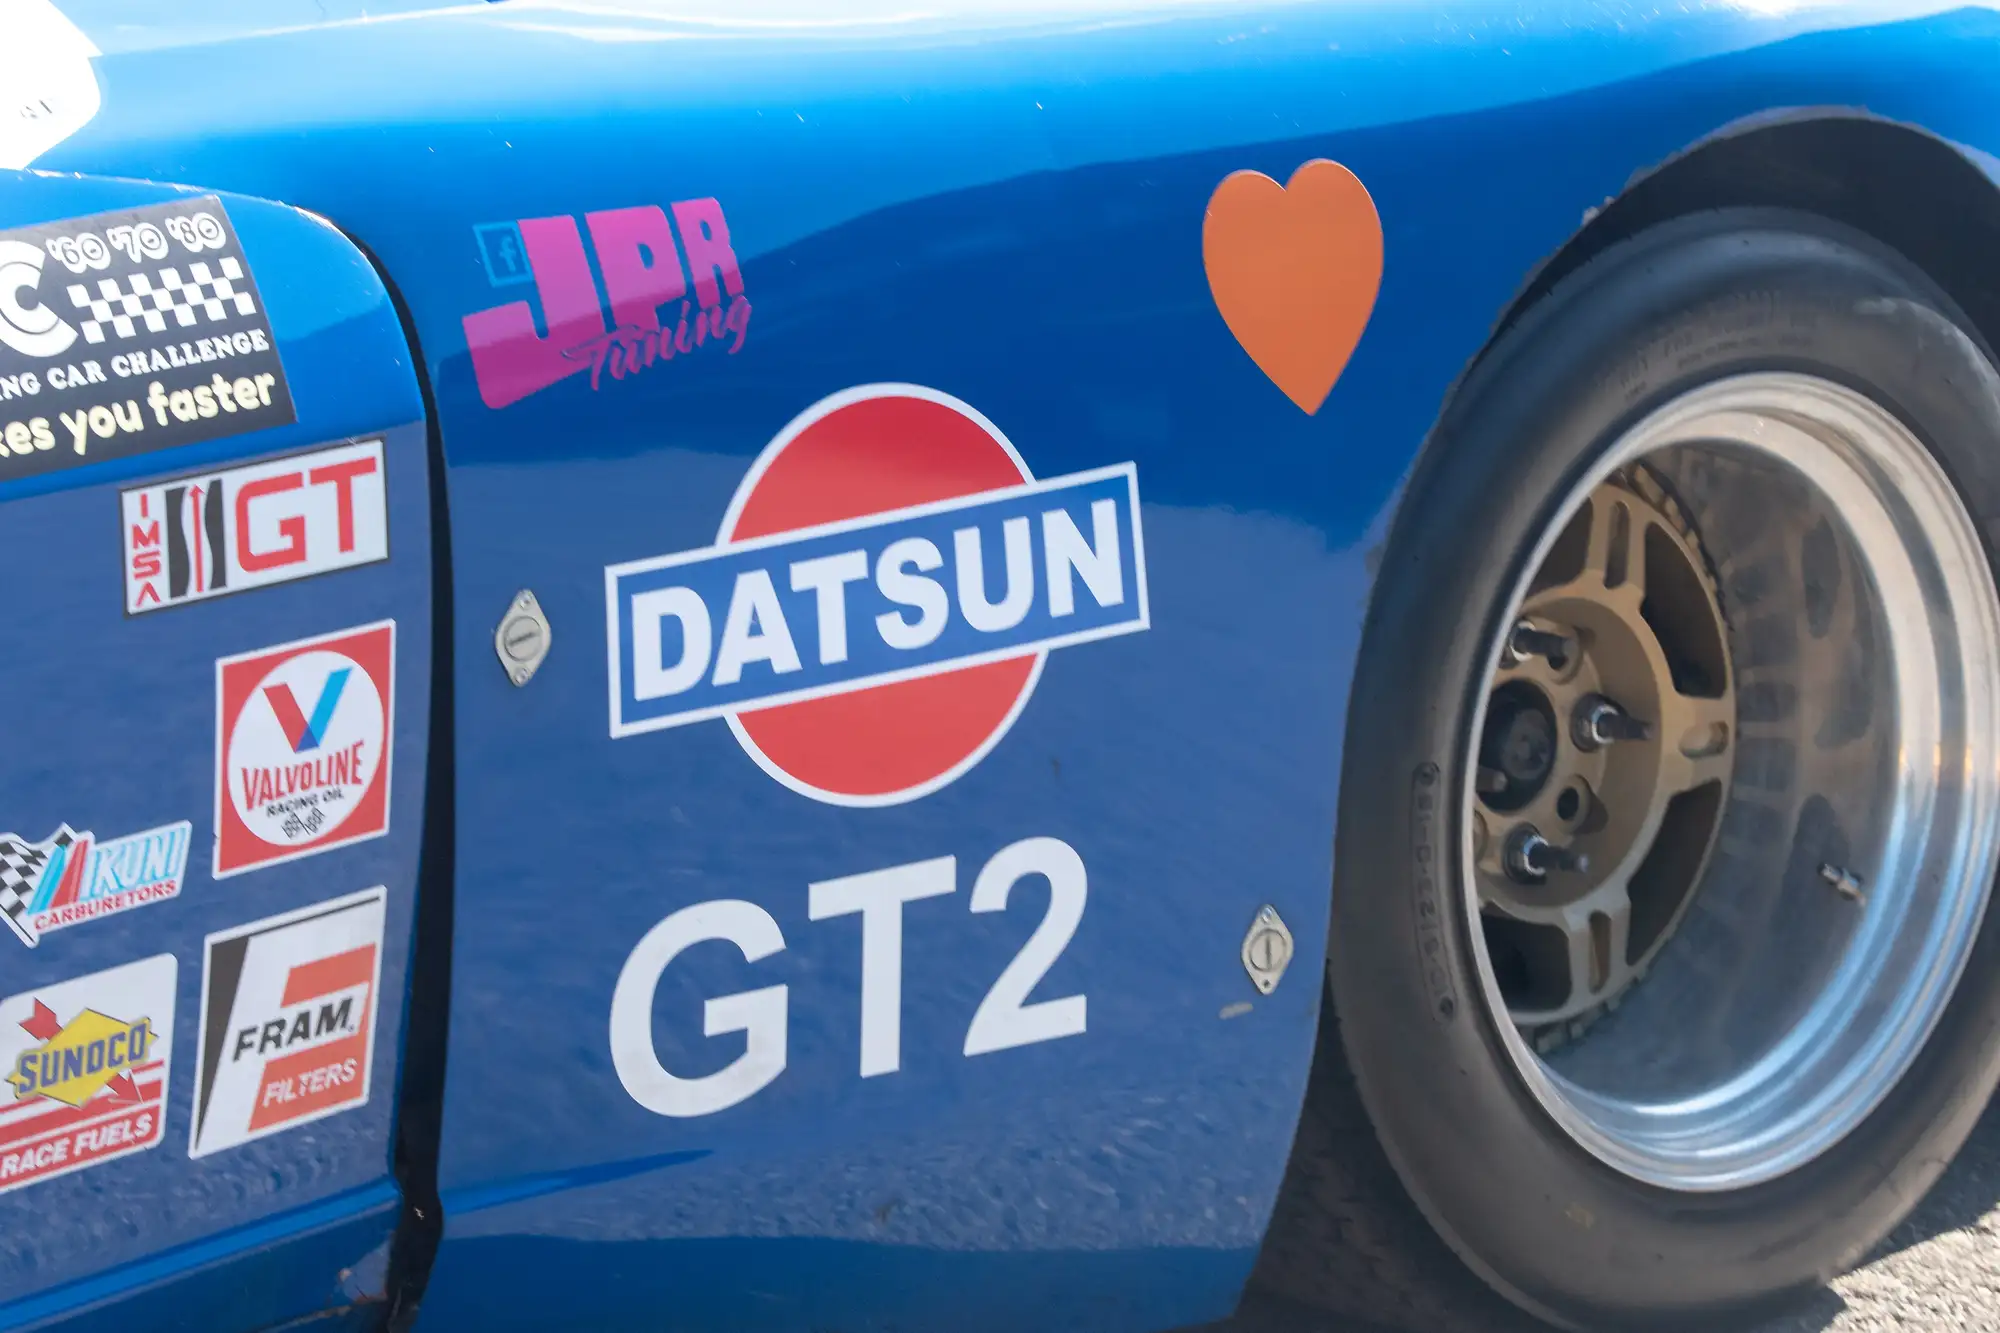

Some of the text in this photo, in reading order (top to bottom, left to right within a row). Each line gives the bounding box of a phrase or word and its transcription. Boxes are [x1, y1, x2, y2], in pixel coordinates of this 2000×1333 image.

[462, 197, 744, 409] JPR
[0, 328, 270, 400] NG CAR CHALLENGE
[561, 295, 752, 391] Tuning
[60, 400, 144, 455] you
[147, 373, 275, 426] faster
[235, 456, 377, 573] GT
[631, 498, 1124, 702] DATSUN
[241, 739, 364, 811] VALVOLINE
[35, 879, 177, 931] CARBURETORS
[609, 837, 1088, 1117] GT2
[18, 1022, 147, 1095] SUNOCO
[233, 998, 353, 1062] FRAM
[262, 1057, 358, 1107] FILTERS
[1, 1112, 152, 1179] RACE FUELS
